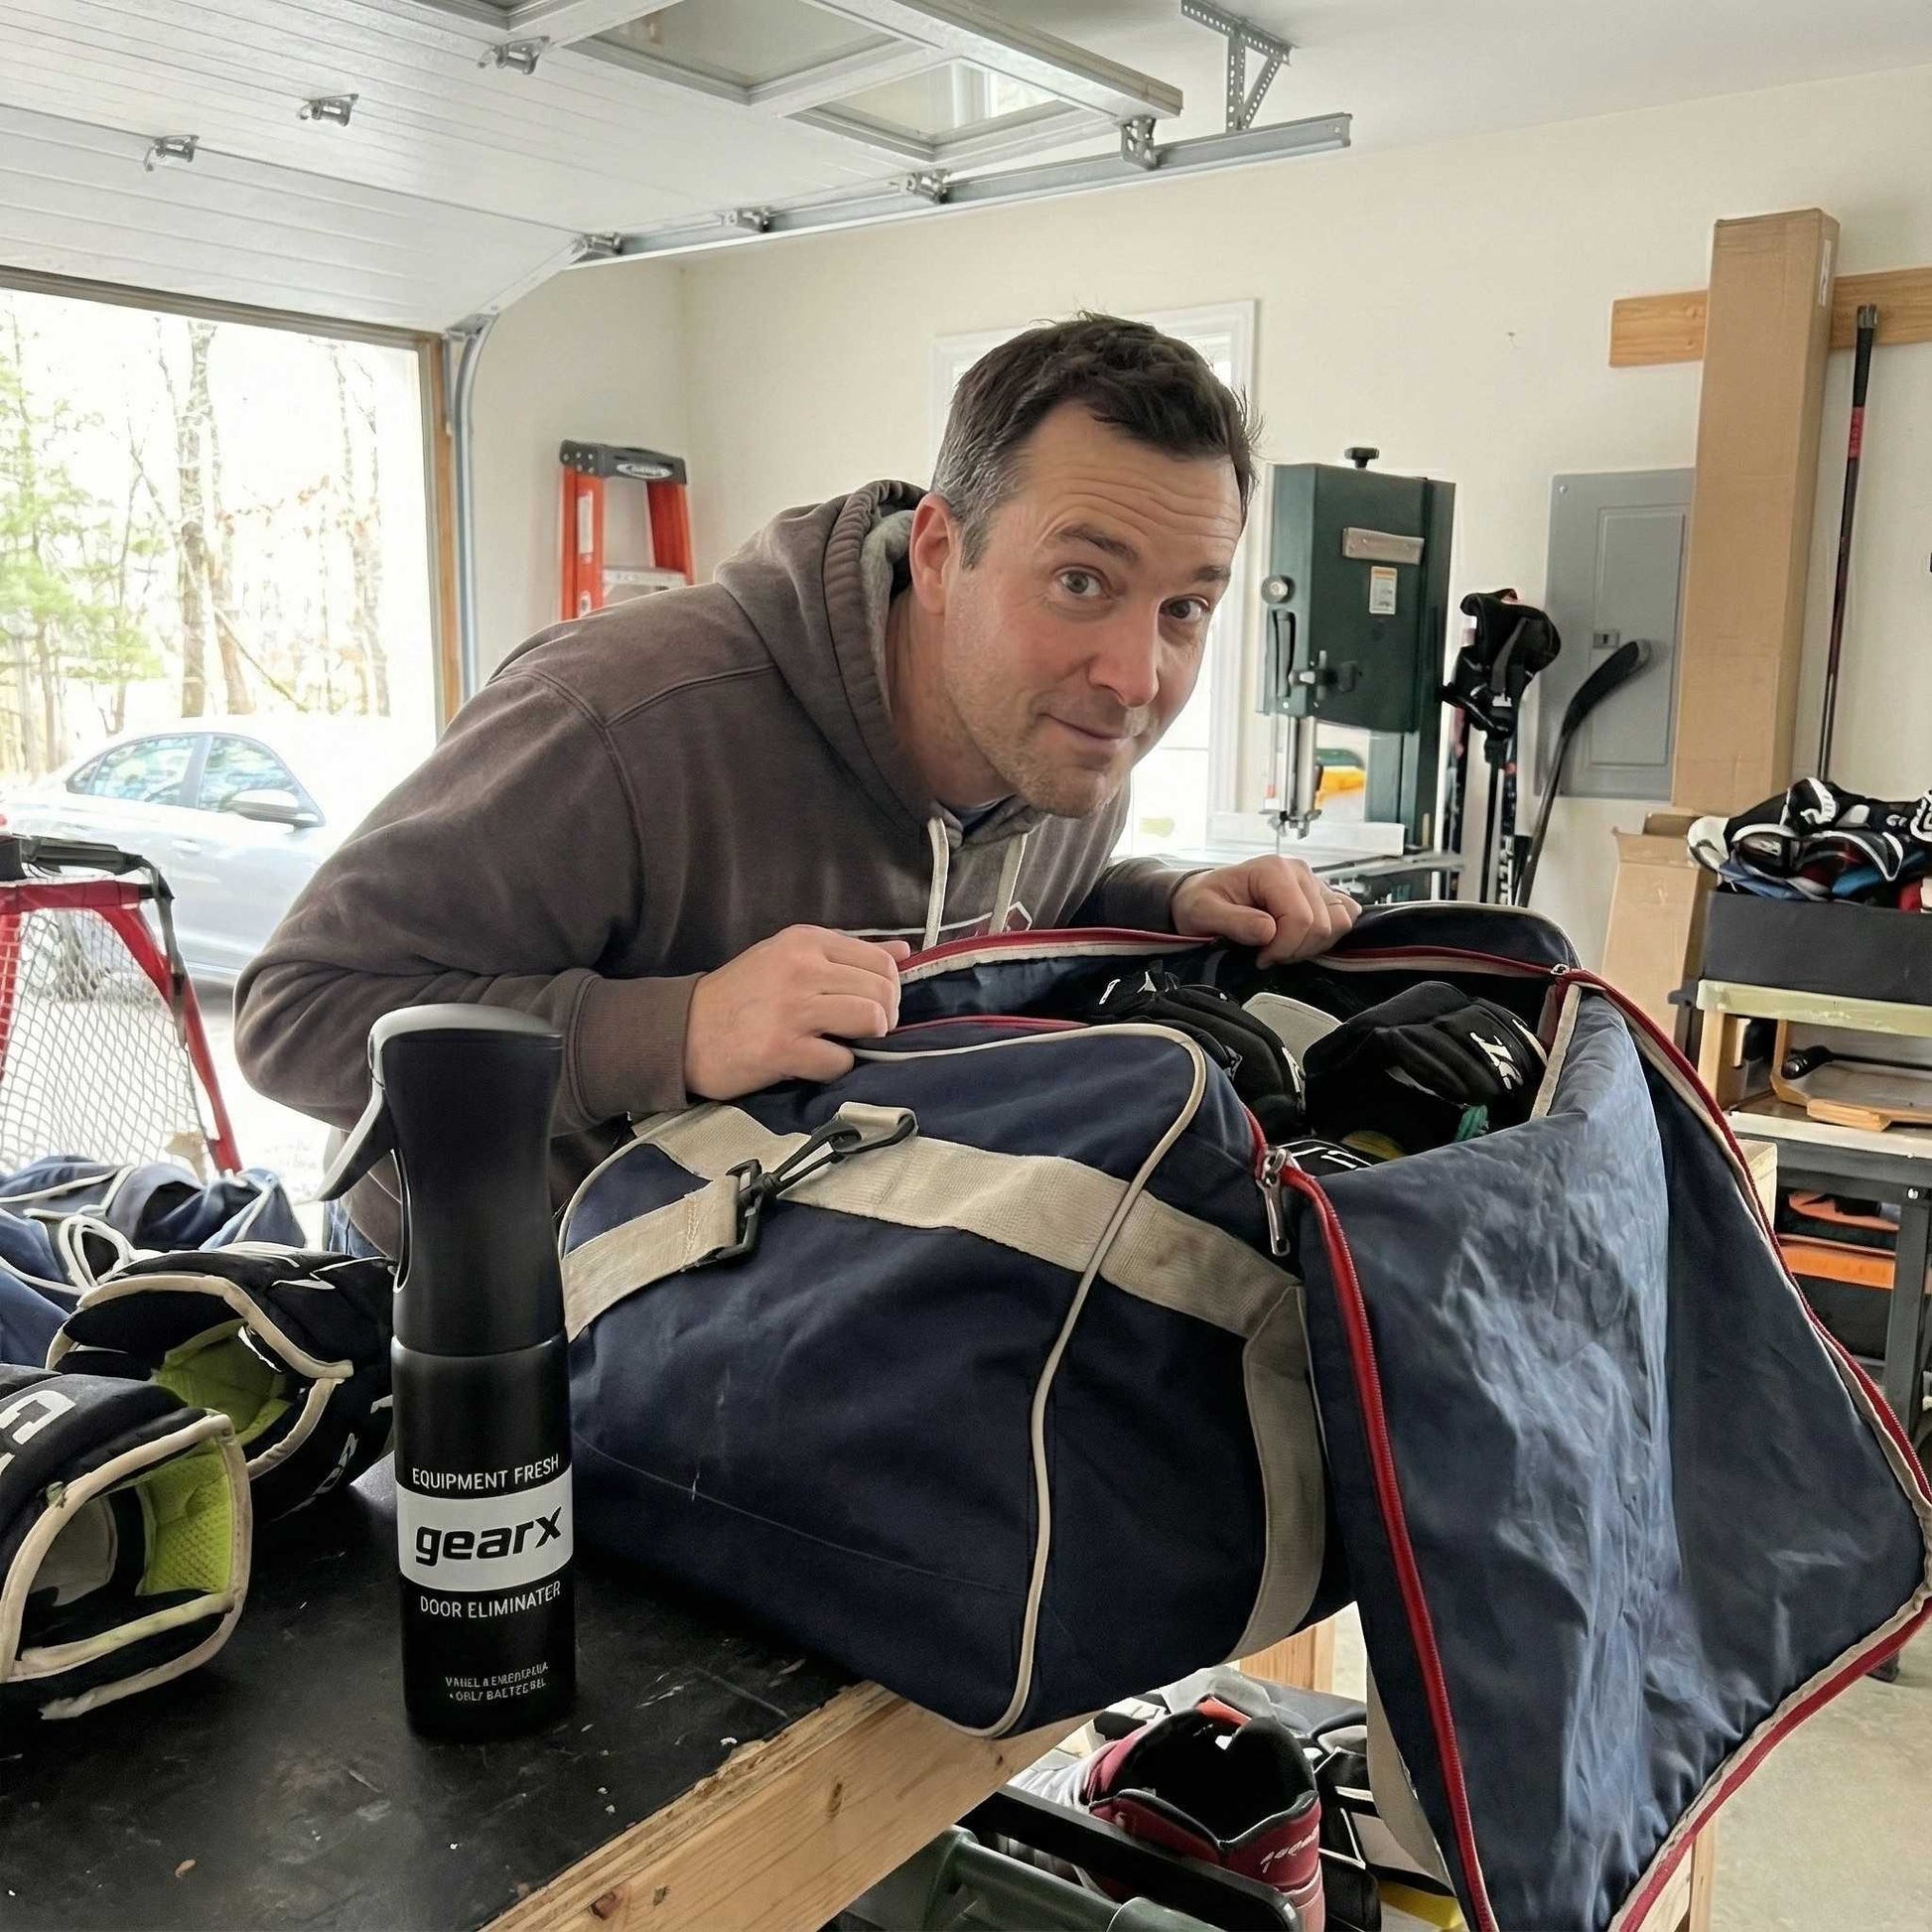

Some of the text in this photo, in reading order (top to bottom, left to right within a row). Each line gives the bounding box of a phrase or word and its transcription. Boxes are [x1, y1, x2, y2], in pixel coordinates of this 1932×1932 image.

[412, 1453, 559, 1490] EQUIPMENT FRESH
[415, 1506, 562, 1567] gearx
[420, 1581, 561, 1618] DOOR ELIMINATER
